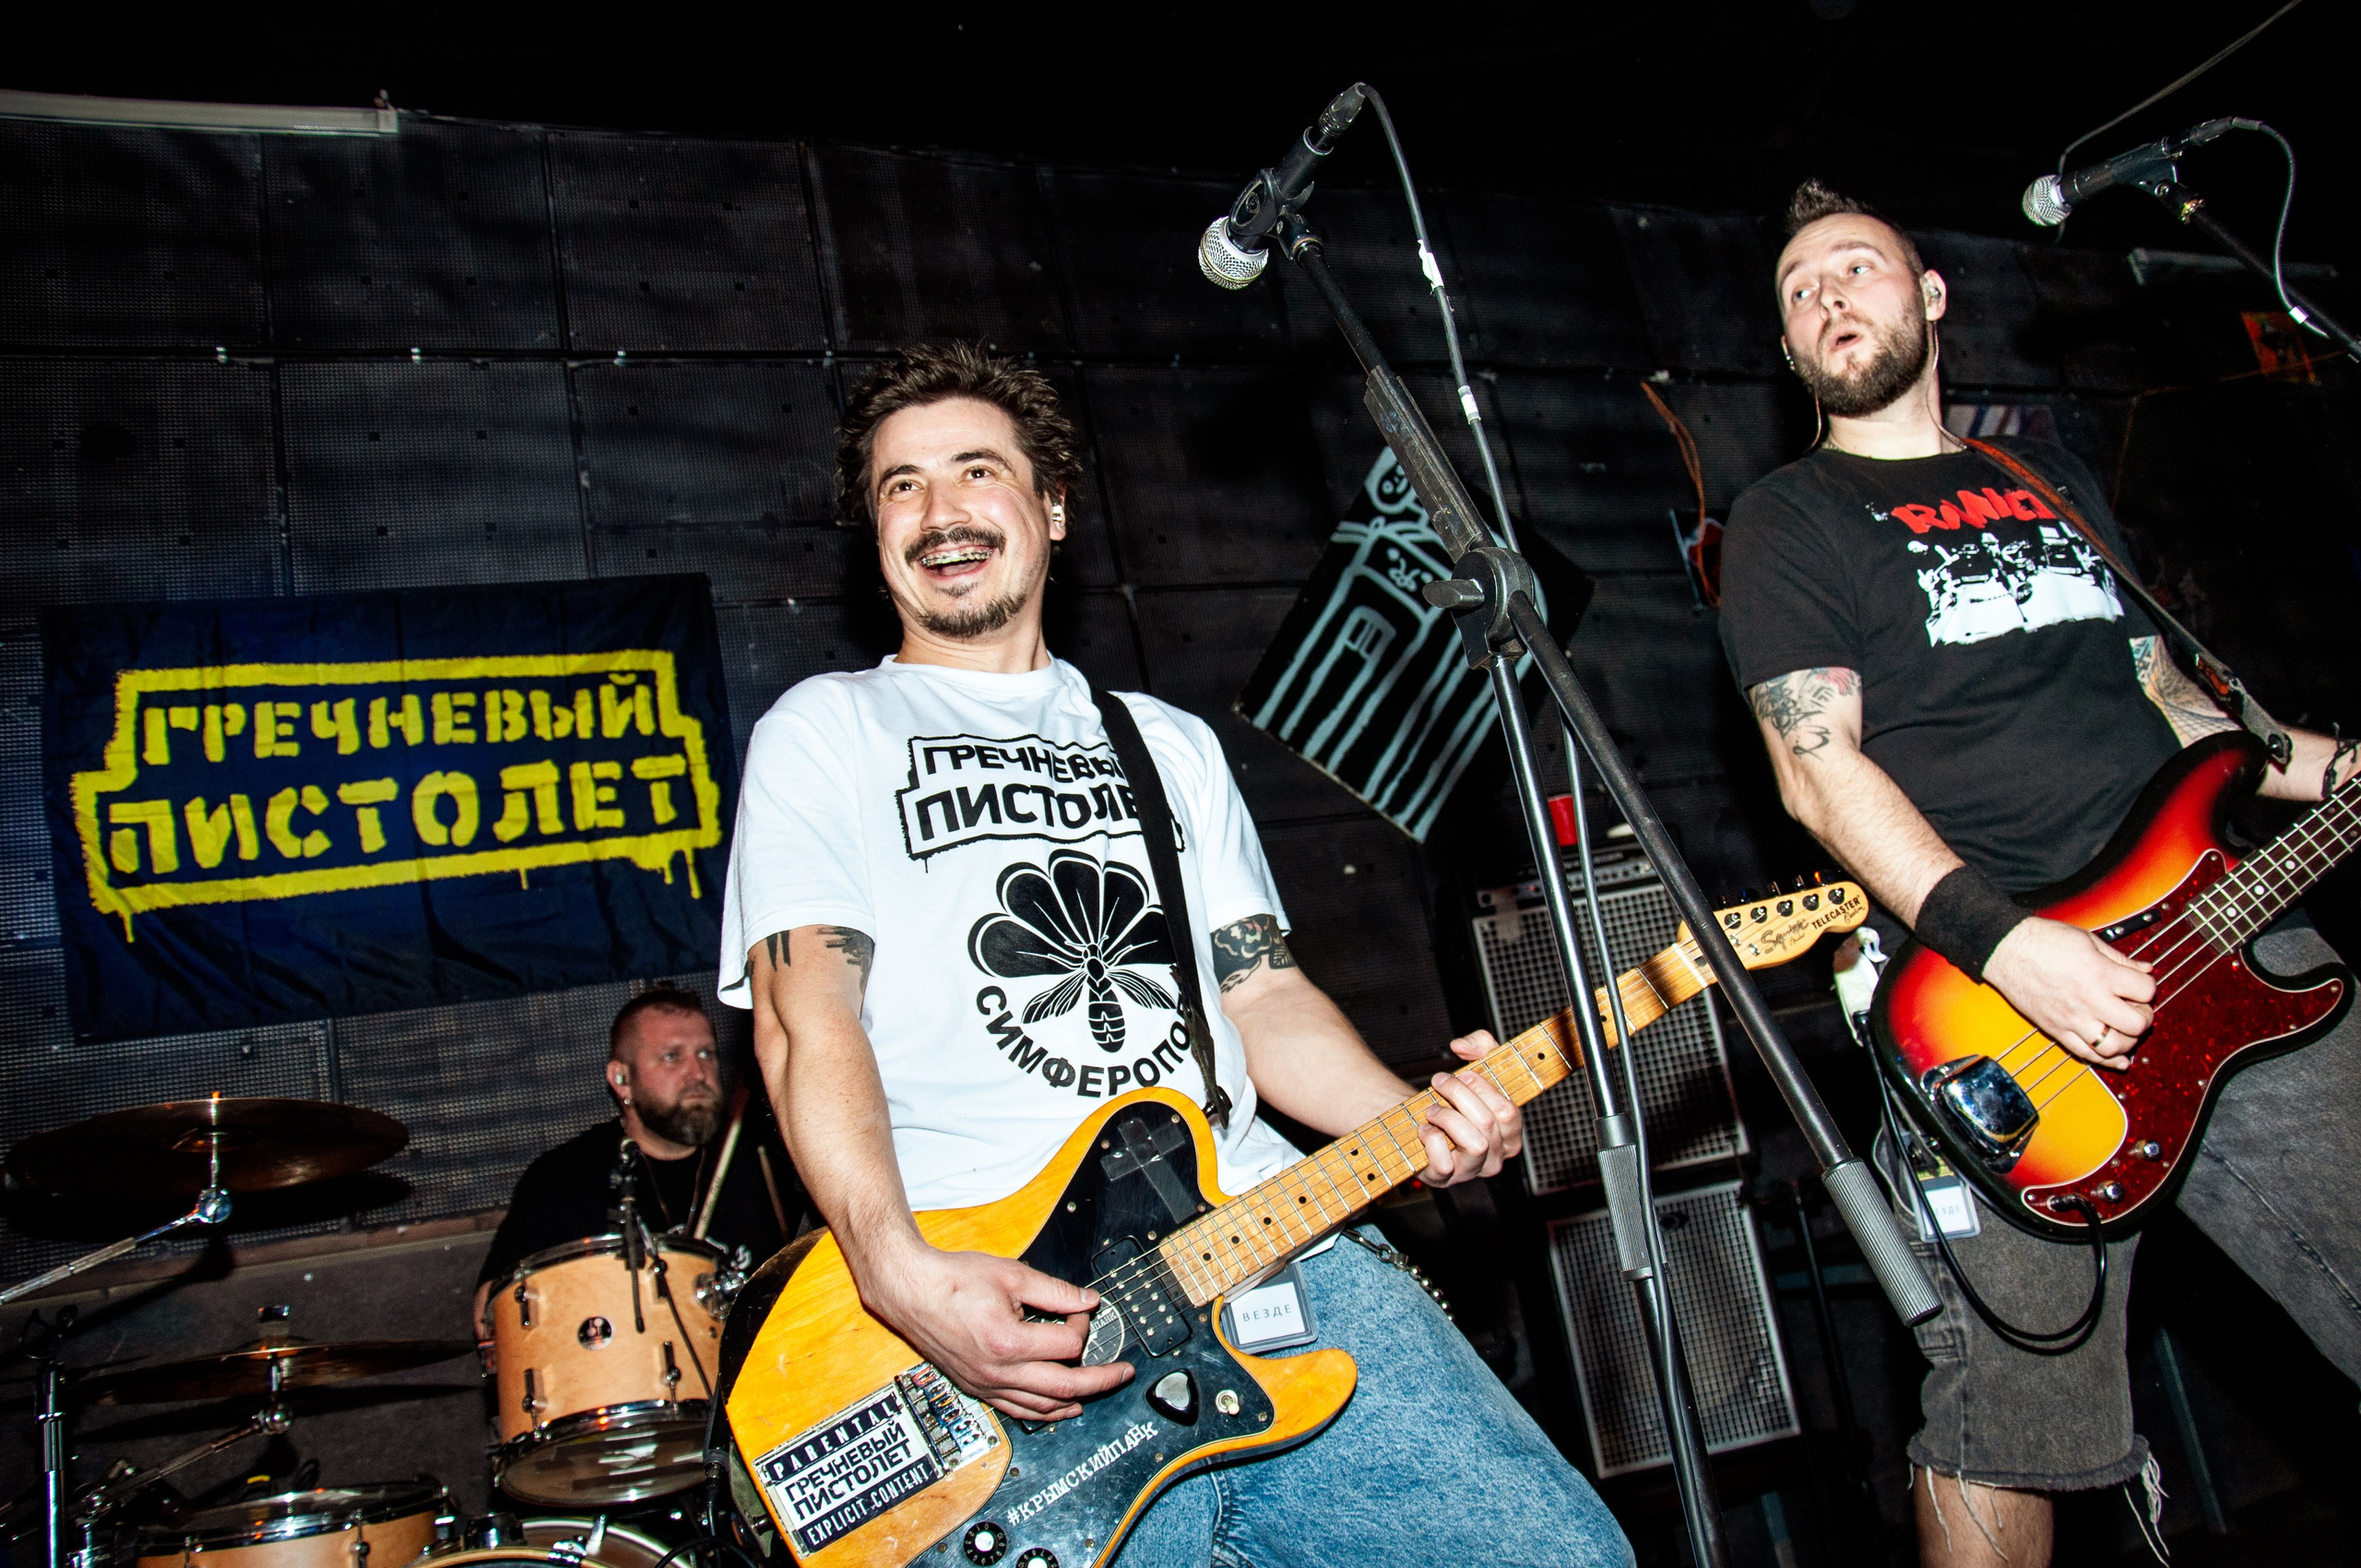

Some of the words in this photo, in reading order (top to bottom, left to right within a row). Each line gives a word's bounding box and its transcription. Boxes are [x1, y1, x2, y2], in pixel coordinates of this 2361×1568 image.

[142, 671, 657, 766] ГРЕЧНЕВЫЙ
[922, 743, 1125, 784] ГРЕЧНЕВЫ
[107, 754, 688, 876] ПИСТОЛЕТ
[915, 783, 1142, 841] ПИСТОЛЕ
[976, 985, 1191, 1098] СИМФЕРОПО
[1242, 1303, 1292, 1323] ВЕЗДЕ
[773, 1401, 895, 1475] PARENTAL
[784, 1420, 907, 1503] ГРЕЧНЕВЫЙ
[792, 1438, 913, 1521] ПИСТОЛЕТ
[1006, 1420, 1159, 1526] #КРЫМСКИЙПАНК
[806, 1500, 868, 1546] EXPLICIT
[870, 1462, 931, 1509] CONTENT
